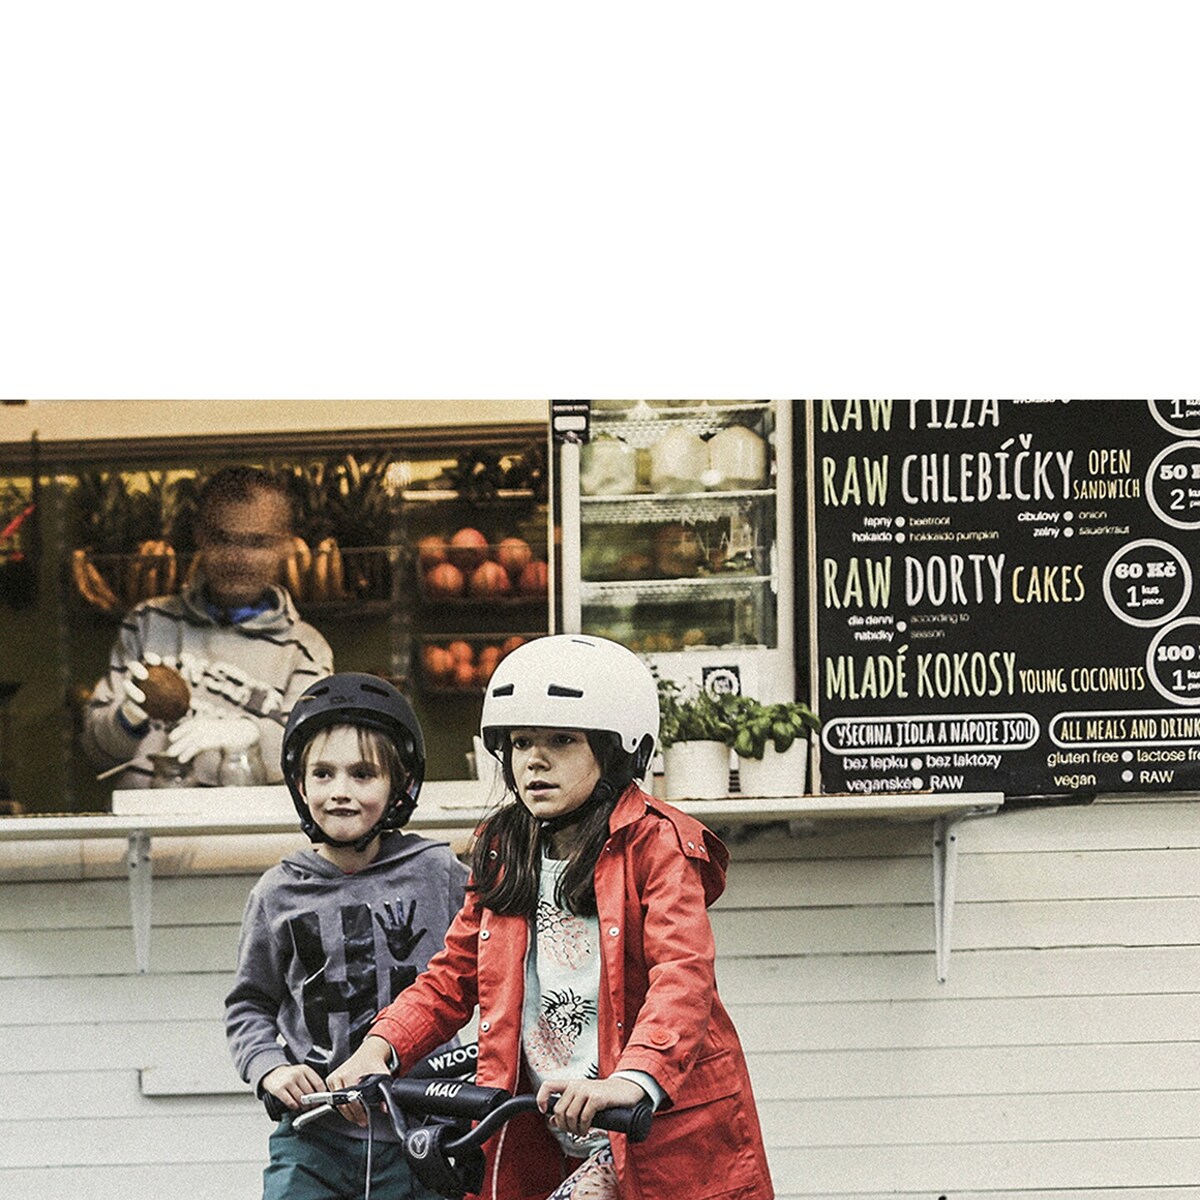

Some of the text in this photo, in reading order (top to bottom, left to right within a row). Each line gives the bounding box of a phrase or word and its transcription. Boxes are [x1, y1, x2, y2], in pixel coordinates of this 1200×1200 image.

[823, 434, 1073, 506] RAW CHLEBÍČKY
[1089, 449, 1130, 475] OPEN
[1158, 462, 1187, 480] 50
[1074, 479, 1140, 499] SANDWICH
[1171, 489, 1185, 510] 2
[1112, 561, 1176, 578] 60 Kč
[824, 554, 1084, 609] RAW DORTY CAKES
[1127, 586, 1140, 607] 1
[1158, 645, 1195, 661] 100
[826, 645, 1147, 700] MLADÉ KOKOSY YOUNG COCONUTS
[1172, 670, 1186, 690] 1
[834, 717, 1037, 748] VŠECHNA JÍDLA A NÁPOJE JSOU
[1061, 718, 1200, 740] ALL MEALS AND DRINK
[843, 757, 868, 770] bez
[870, 756, 908, 771] lepku
[926, 755, 951, 767] bez
[1047, 748, 1200, 767] gluten free lactose fre
[929, 776, 964, 791] RAW
[1054, 770, 1174, 788] vegan RAW
[428, 1045, 479, 1072] WZOO
[425, 1082, 462, 1098] MAU
